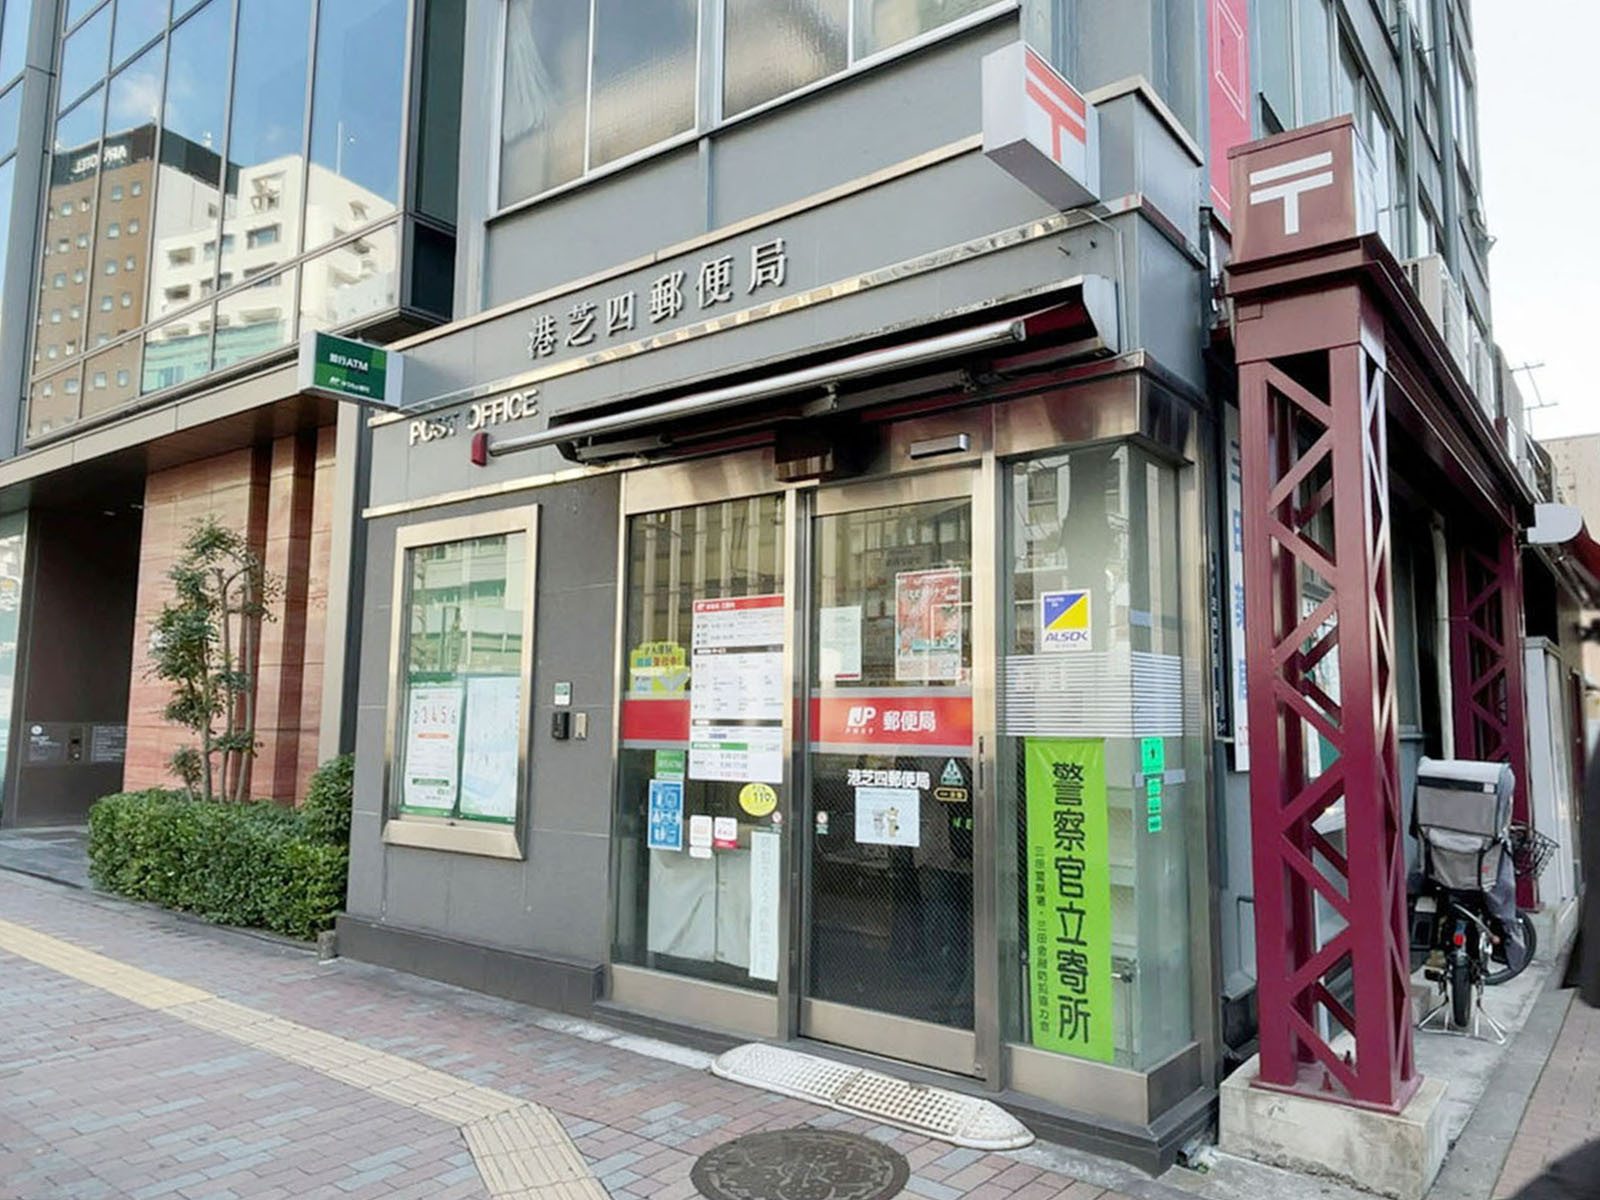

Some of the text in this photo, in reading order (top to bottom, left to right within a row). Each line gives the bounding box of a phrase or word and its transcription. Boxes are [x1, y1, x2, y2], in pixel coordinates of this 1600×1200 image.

[528, 237, 786, 360] 港芝四郵便局
[882, 710, 937, 732] 郵便局
[847, 768, 931, 791] 港芝四郵便局
[1052, 762, 1092, 1045] 警察官立寄所
